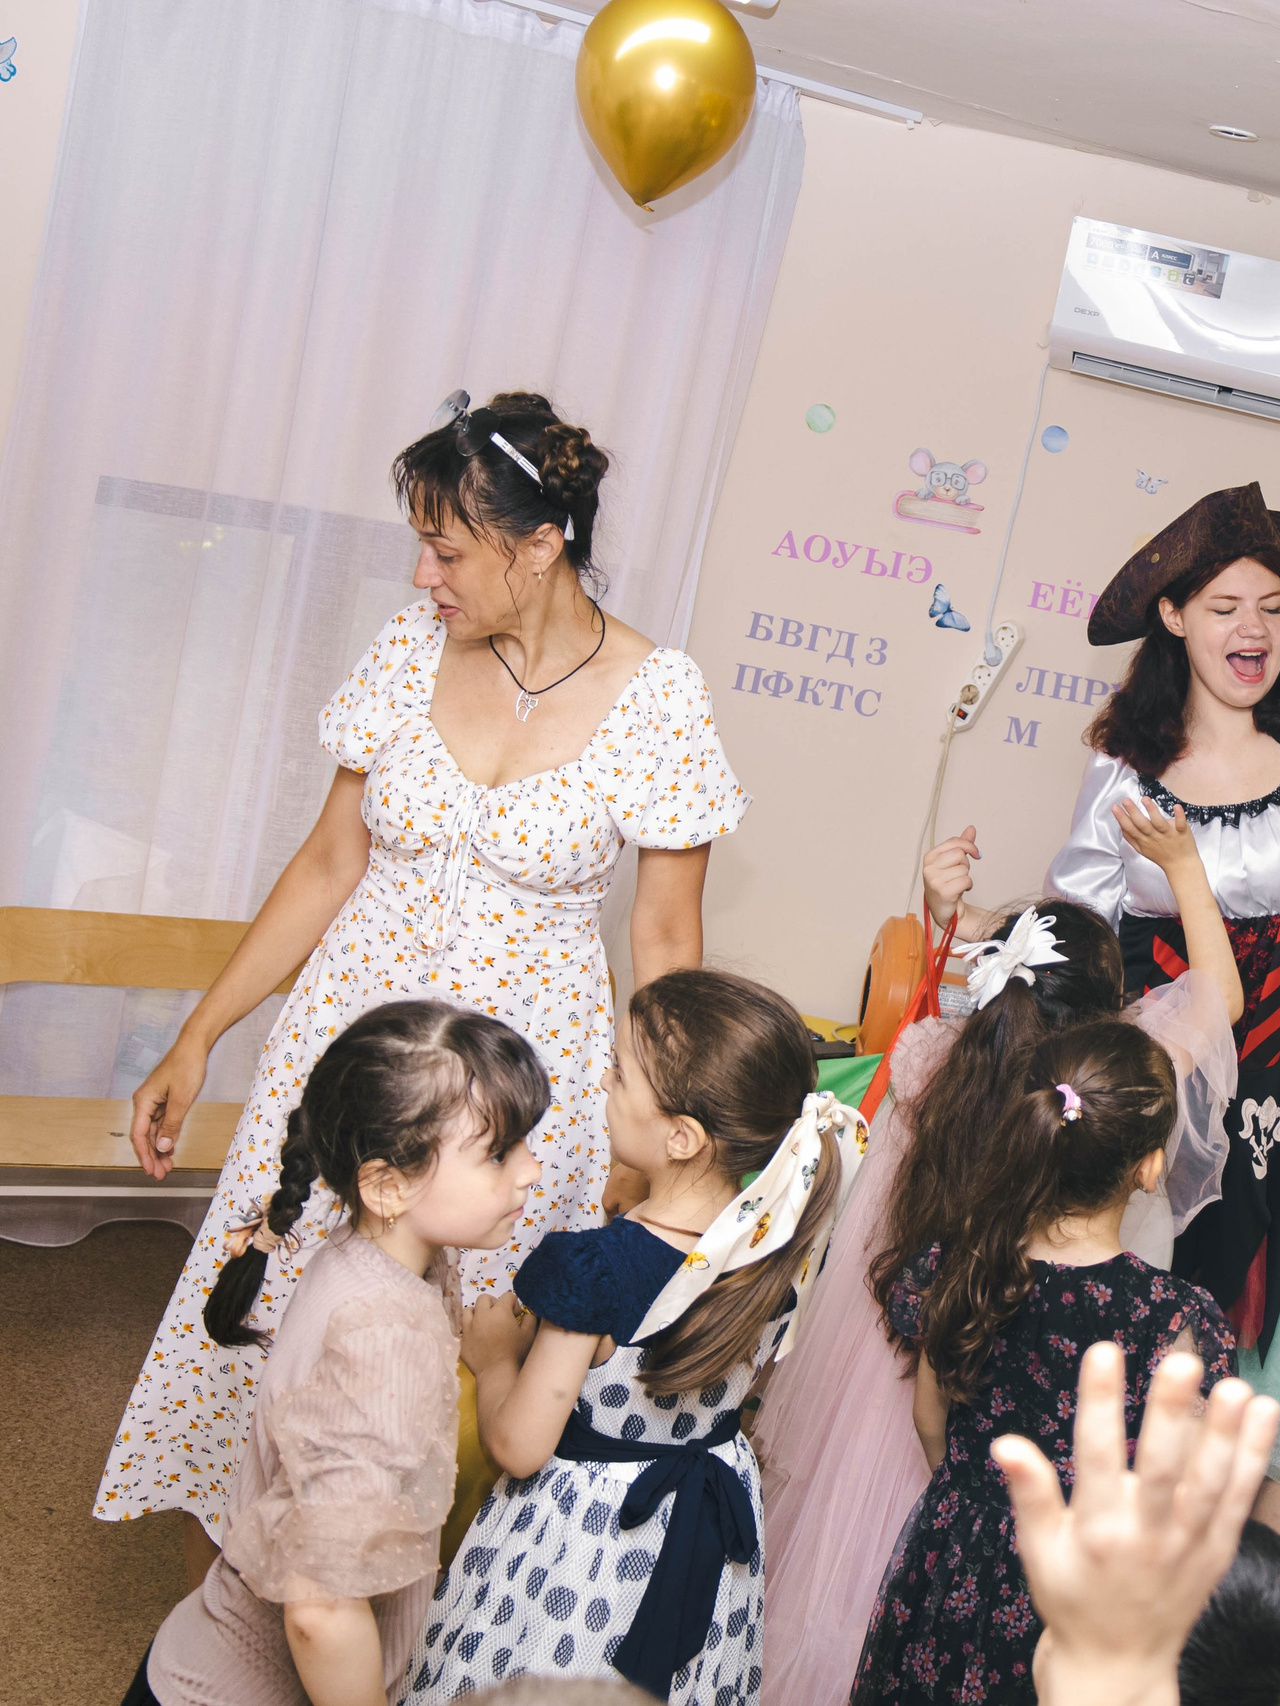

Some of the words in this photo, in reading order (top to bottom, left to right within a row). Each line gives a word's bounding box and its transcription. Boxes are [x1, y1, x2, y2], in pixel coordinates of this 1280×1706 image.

[1074, 306, 1100, 317] DEXP
[771, 529, 933, 584] АОУЫЭ
[1027, 579, 1100, 621] ЕЁ
[731, 663, 882, 717] ПФКТС
[1016, 666, 1122, 706] ЛНР
